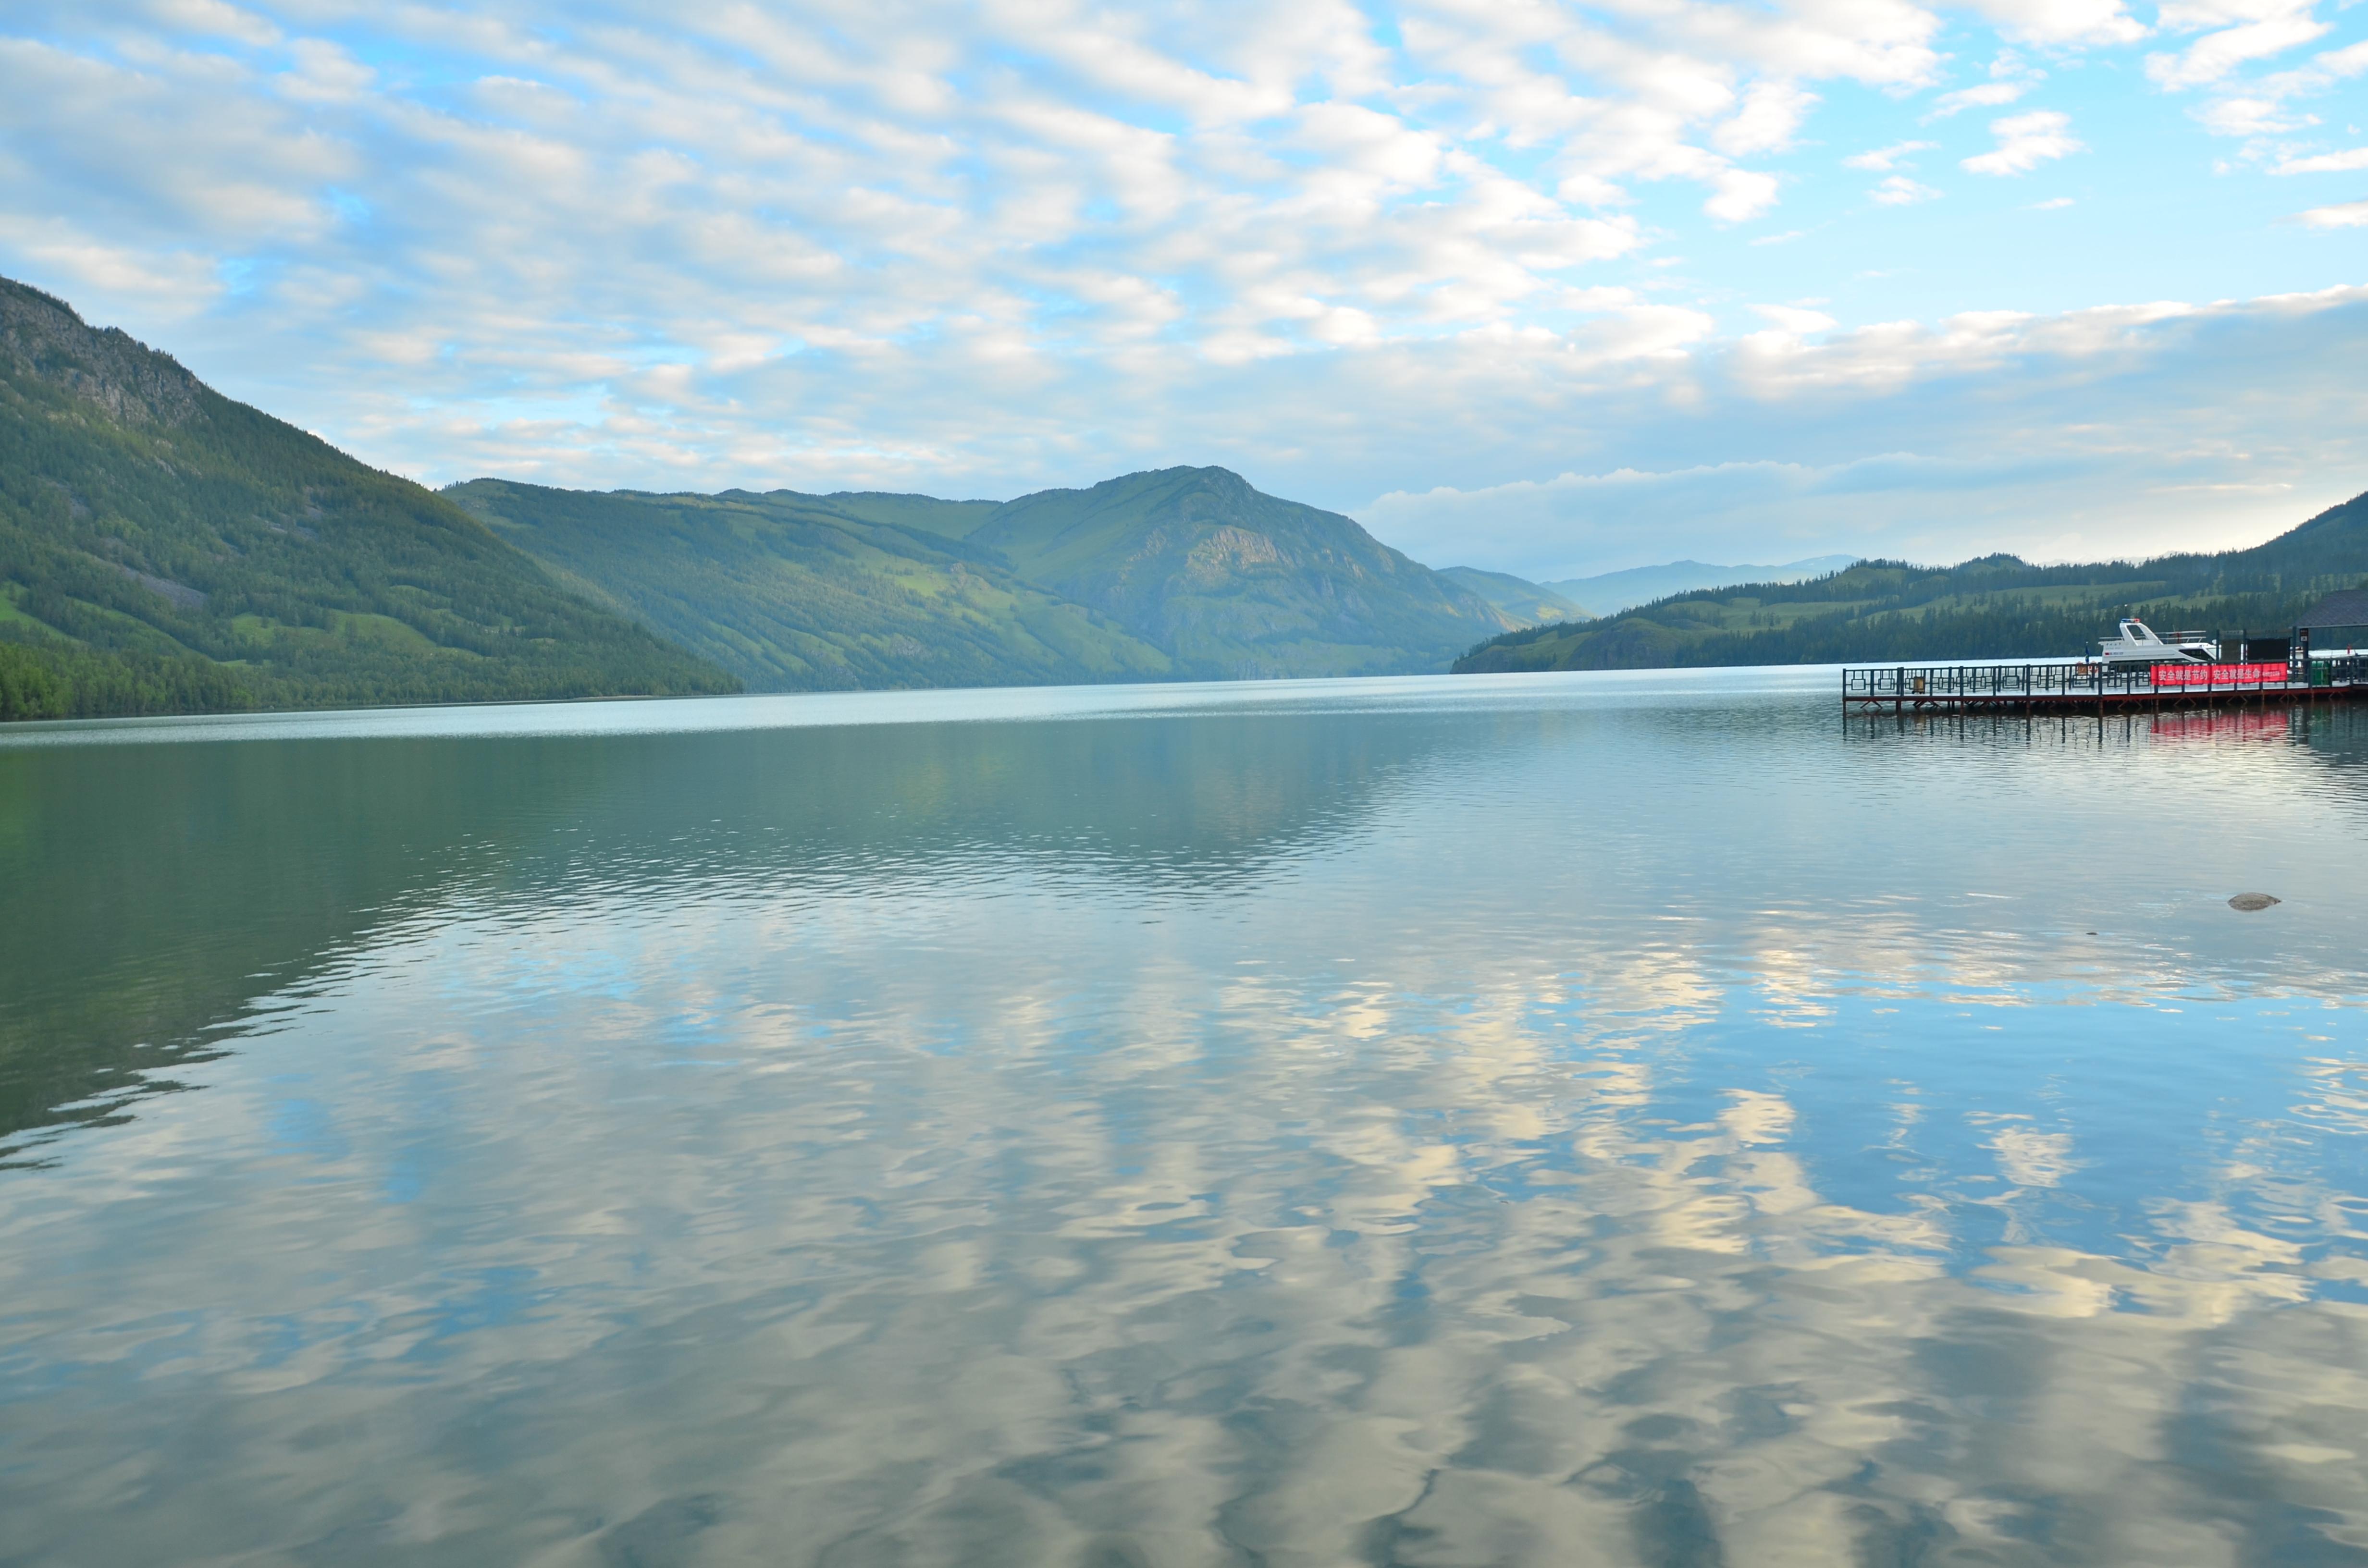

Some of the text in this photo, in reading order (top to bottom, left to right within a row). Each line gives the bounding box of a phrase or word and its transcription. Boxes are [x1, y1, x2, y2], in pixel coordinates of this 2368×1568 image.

[2158, 670, 2208, 681] 安全就是节约
[2213, 668, 2260, 680] 安全就是生命
